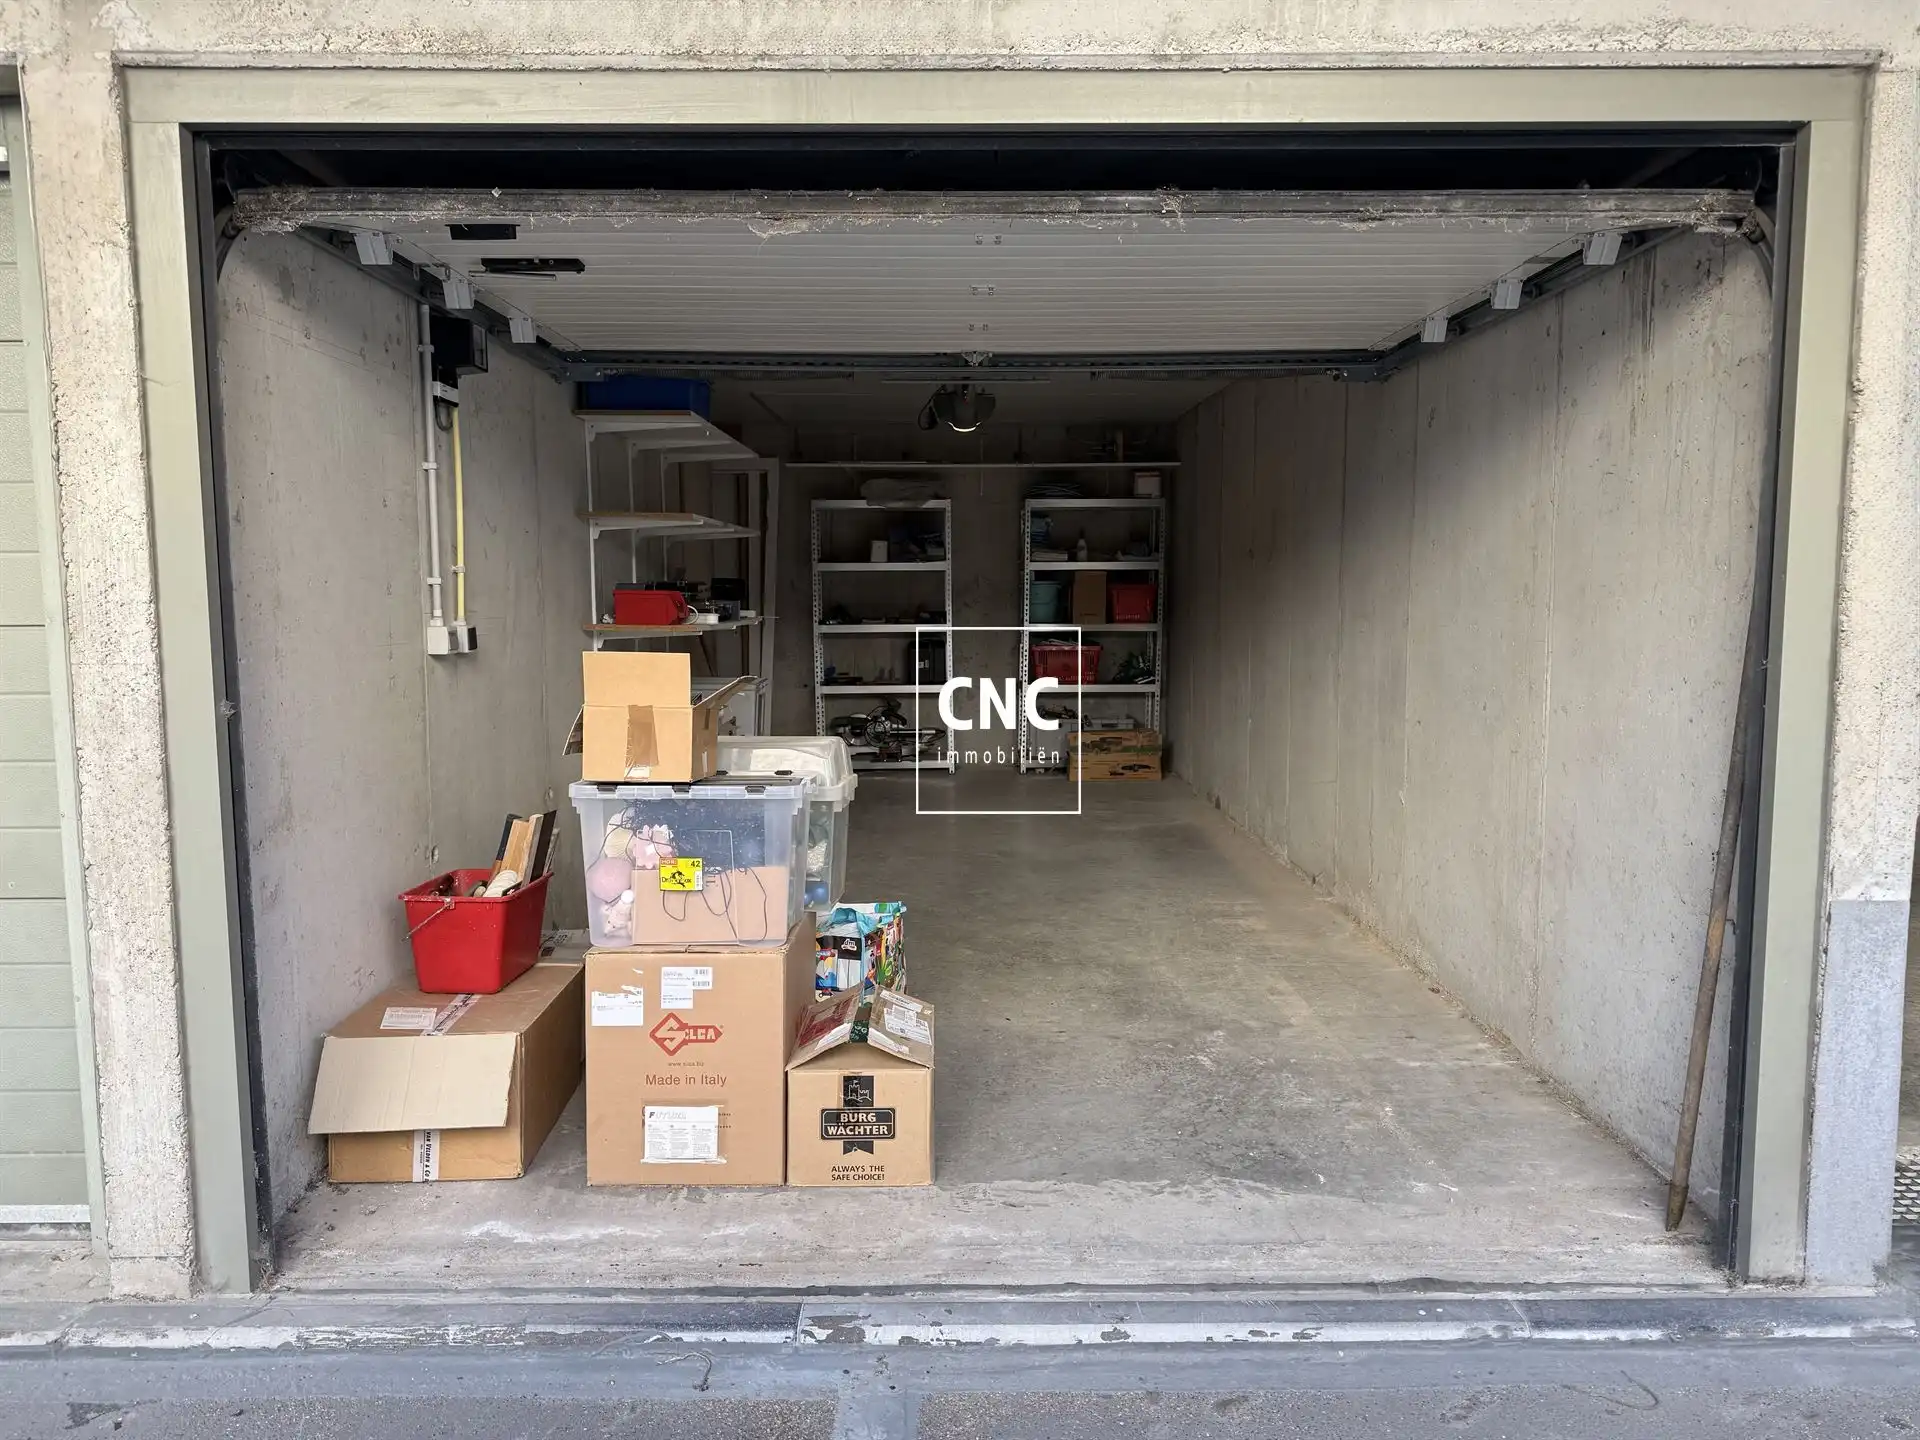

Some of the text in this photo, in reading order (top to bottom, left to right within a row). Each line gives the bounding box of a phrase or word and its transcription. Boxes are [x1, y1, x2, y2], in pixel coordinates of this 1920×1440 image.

[691, 860, 701, 868] 42
[645, 1074, 727, 1087] Made in Italy
[840, 1112, 877, 1123] BURG
[827, 1123, 888, 1135] WÄCHTER
